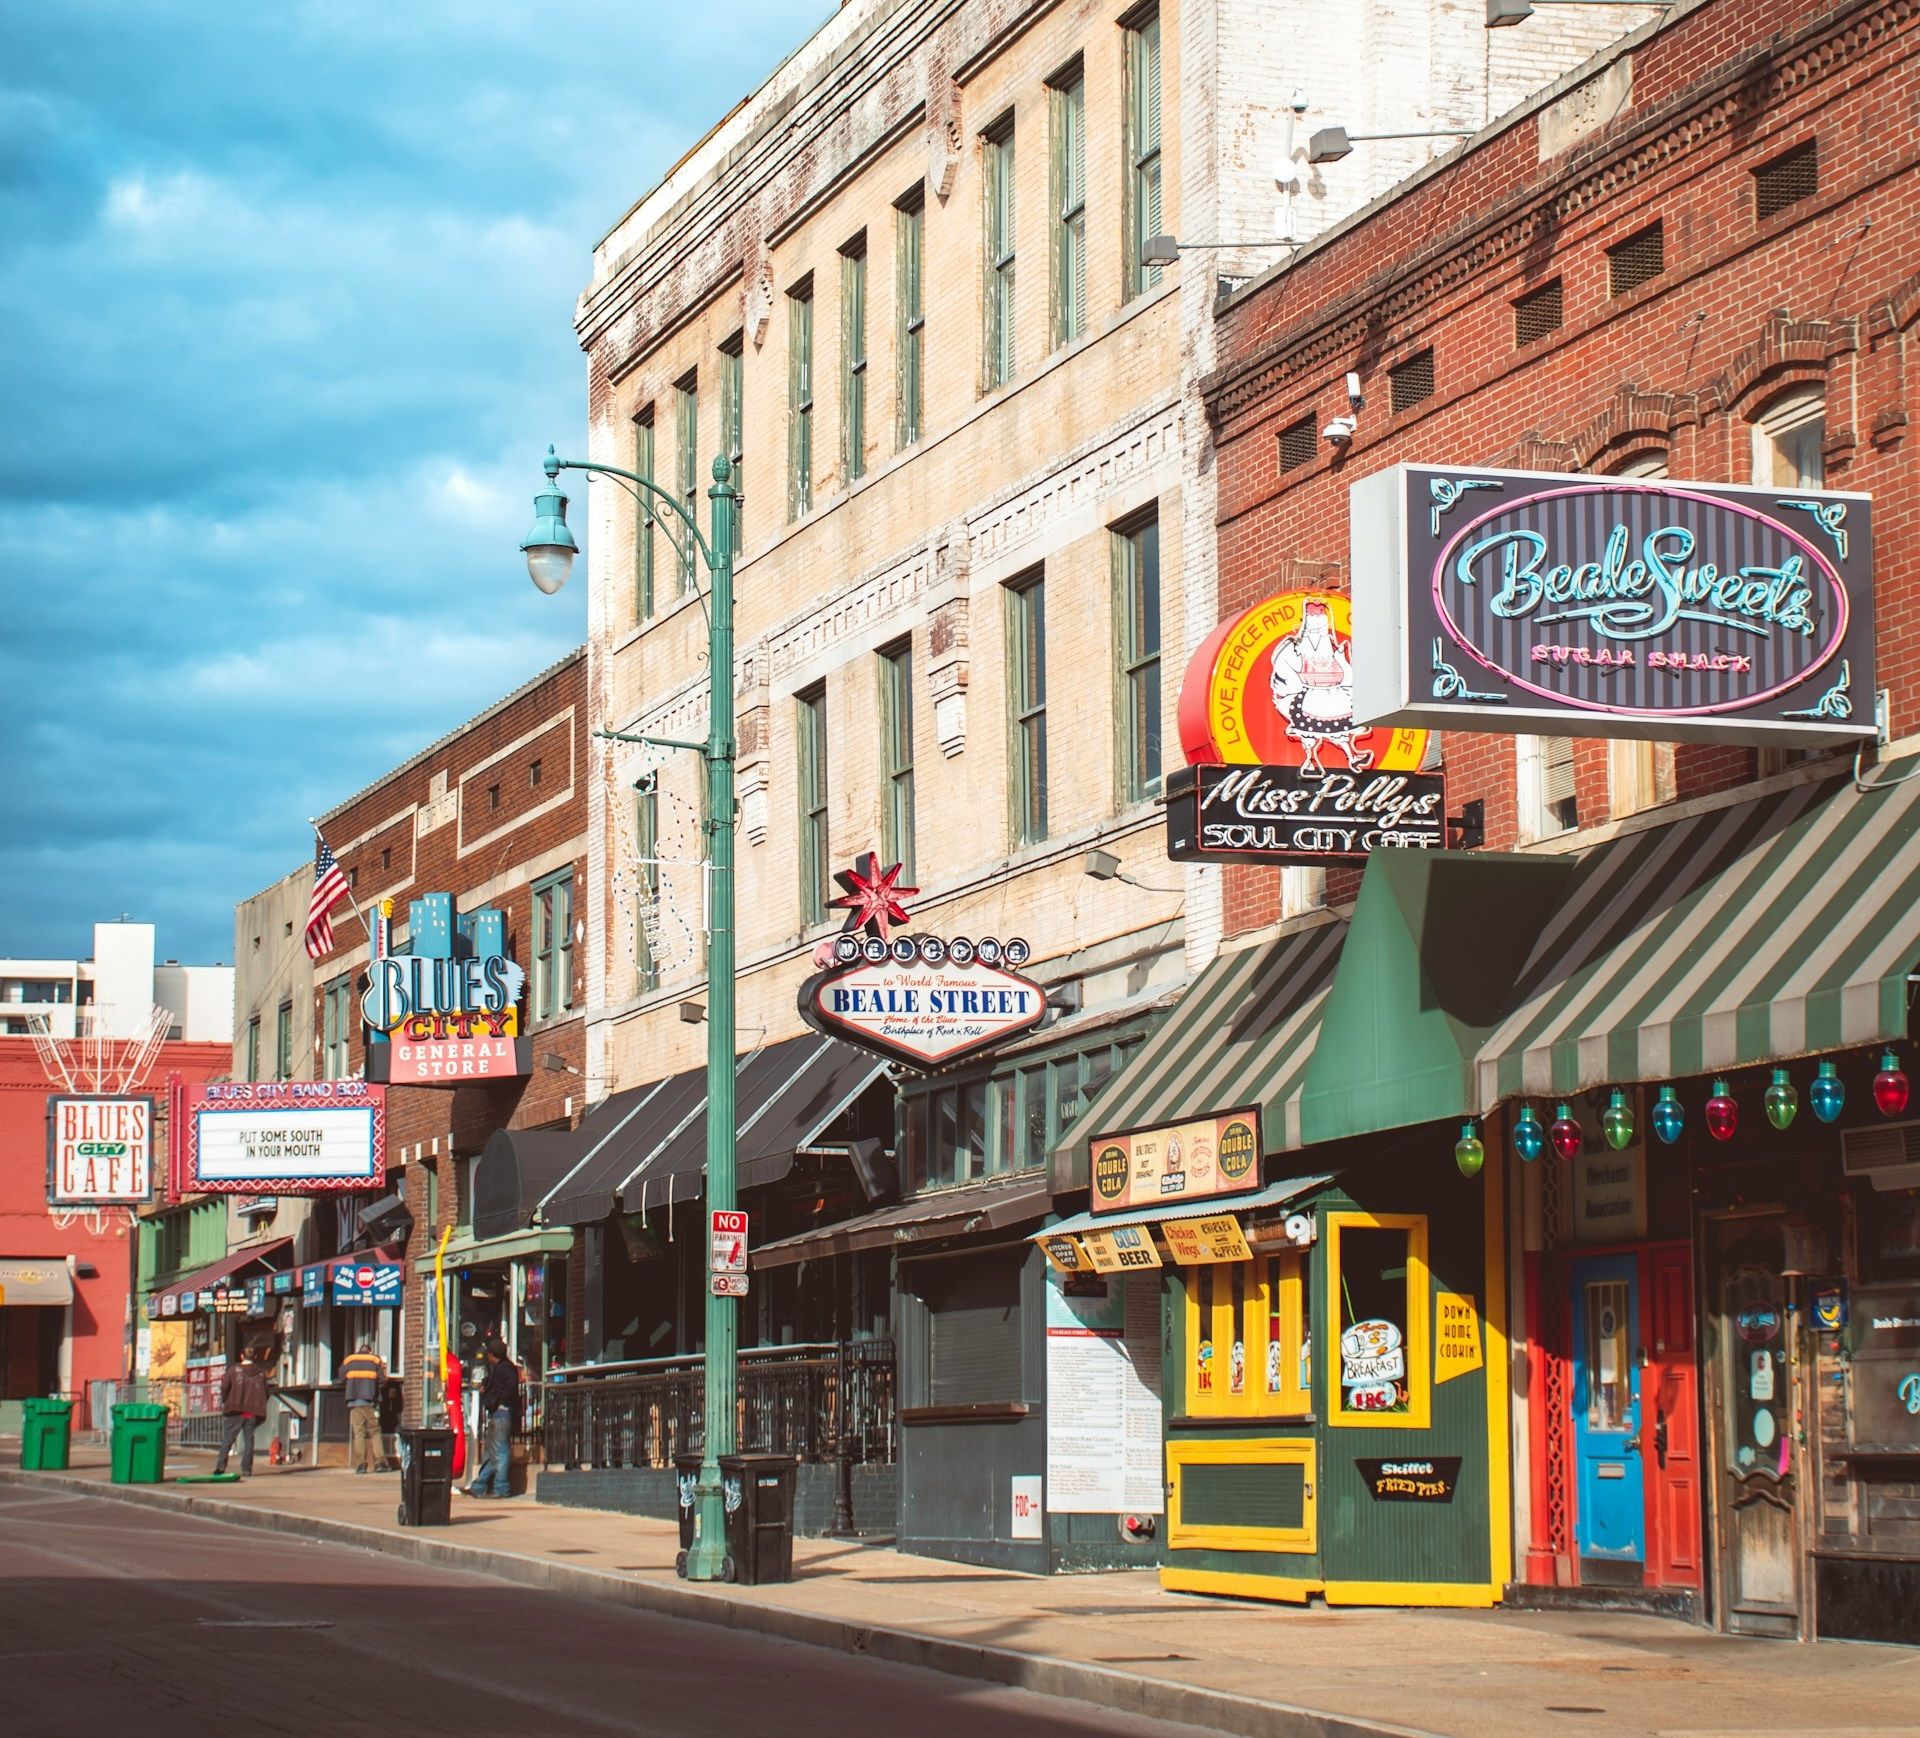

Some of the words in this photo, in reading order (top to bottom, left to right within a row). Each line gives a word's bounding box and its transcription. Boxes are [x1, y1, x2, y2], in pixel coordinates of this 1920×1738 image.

[1263, 604, 1295, 632] AND
[1227, 625, 1264, 683] PEACE
[1531, 643, 1636, 666] SUGAR
[1648, 650, 1752, 673] SHACK
[1222, 688, 1241, 745] LOVE,
[1201, 769, 1312, 815] Miss
[1203, 824, 1289, 849] SOUL
[1293, 827, 1357, 851] CITY
[836, 938, 1028, 962] WELCOME
[883, 976, 895, 987] to
[896, 974, 934, 987] World
[935, 974, 978, 988] Famous
[382, 955, 509, 1031] BLUES
[832, 988, 920, 1013] BEALE
[929, 989, 1030, 1014] STREET
[403, 1013, 514, 1042] CITY
[883, 1015, 908, 1025] Home
[912, 1015, 919, 1025] of
[921, 1015, 933, 1024] the
[936, 1015, 958, 1024] Blues
[880, 1025, 924, 1038] Birthplace
[926, 1028, 934, 1038] of
[935, 1025, 954, 1036] Rock
[963, 1025, 987, 1036] Roll
[399, 1042, 508, 1061] GENERAL
[417, 1059, 489, 1077] STORE
[207, 1084, 253, 1099] BLUES
[256, 1084, 289, 1098] CITY
[292, 1083, 332, 1097] BAND
[336, 1082, 368, 1096] BOX
[63, 1105, 144, 1140] BLUES
[240, 1131, 257, 1144] PUT
[261, 1131, 287, 1143] SOME
[290, 1130, 323, 1142] SOUTH
[1221, 1133, 1252, 1155] DOUBLE
[246, 1146, 256, 1158] IN
[258, 1146, 281, 1157] YOUR
[284, 1144, 321, 1157] MOUTH
[63, 1144, 143, 1194] CAFE
[1097, 1157, 1127, 1176] DOUBLE
[1225, 1154, 1247, 1172] COLA
[1101, 1177, 1121, 1193] COLA
[718, 1214, 741, 1230] NO
[714, 1233, 742, 1242] PARKING
[1165, 1225, 1197, 1240] Chicken
[1048, 1243, 1073, 1252] KITCHEN
[1174, 1241, 1200, 1258] Wings
[1117, 1250, 1153, 1267] BEER
[1444, 1305, 1471, 1319] DOWN
[1444, 1324, 1471, 1339] HOME
[1346, 1356, 1399, 1379] BREAKFAST
[1381, 1462, 1434, 1475] Skillet
[1376, 1478, 1416, 1494] FRIED
[1416, 1479, 1446, 1497] PIES
[1015, 1495, 1029, 1517] FDC
